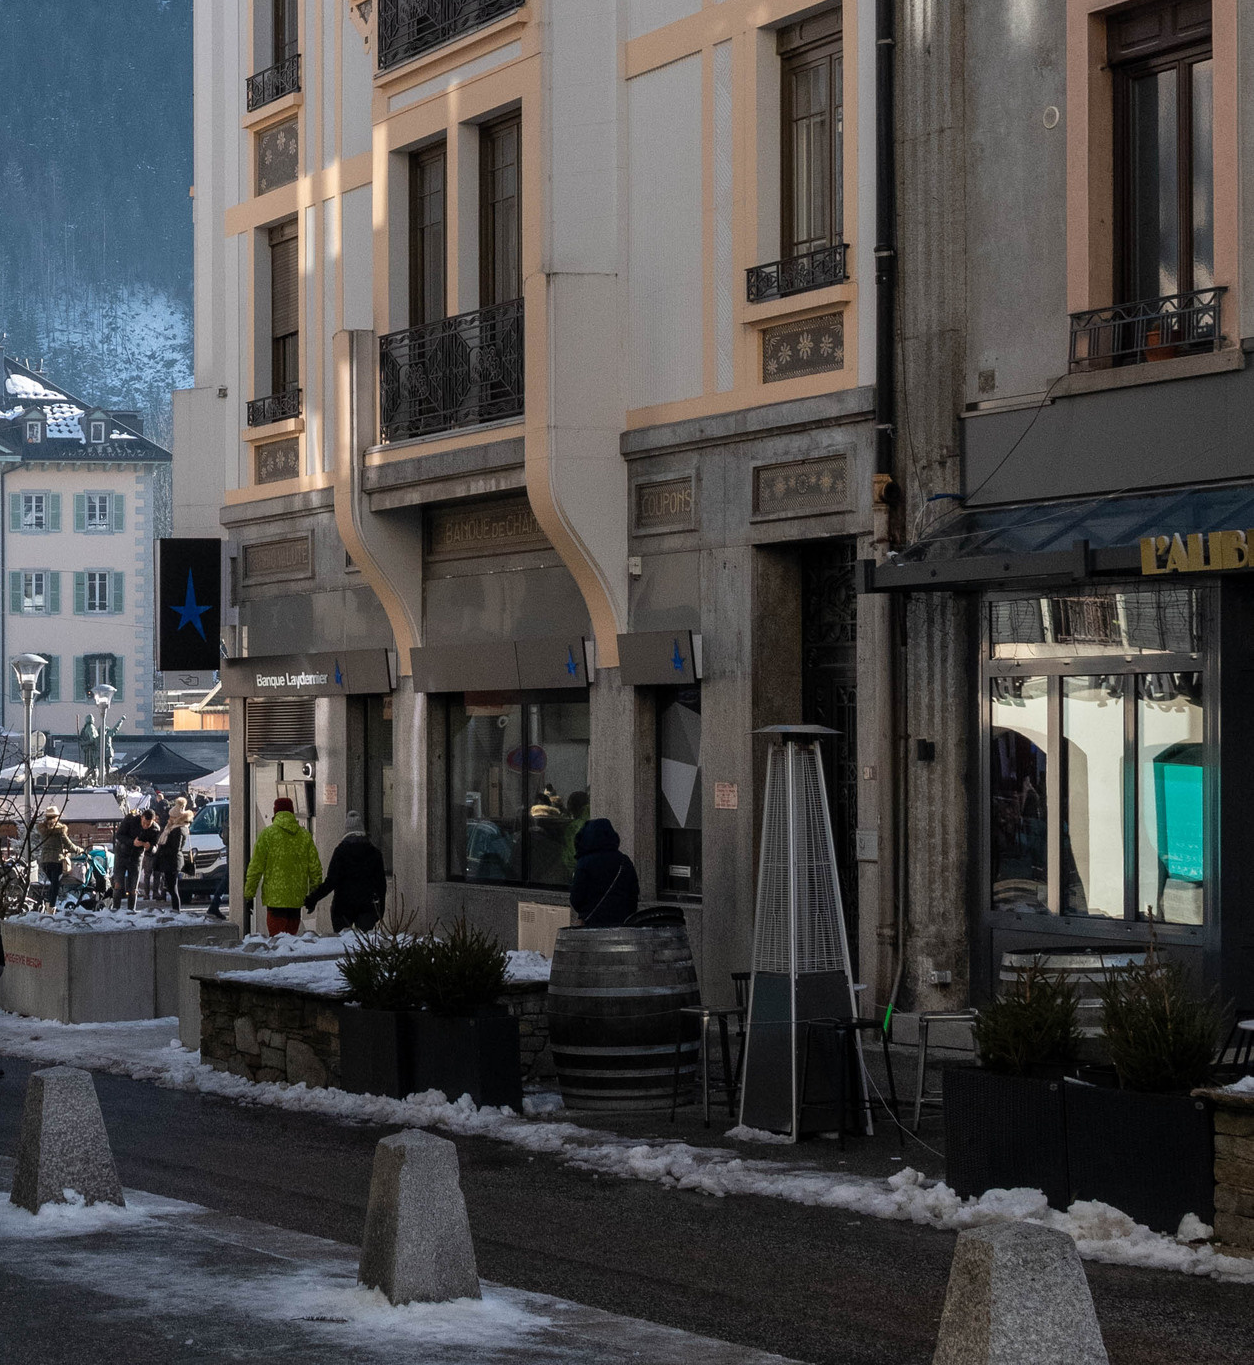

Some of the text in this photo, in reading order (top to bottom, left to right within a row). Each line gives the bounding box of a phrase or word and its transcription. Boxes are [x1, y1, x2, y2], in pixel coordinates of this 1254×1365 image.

[641, 489, 691, 516] COUPONS
[445, 518, 490, 543] BANQUE
[256, 674, 286, 689] Banque
